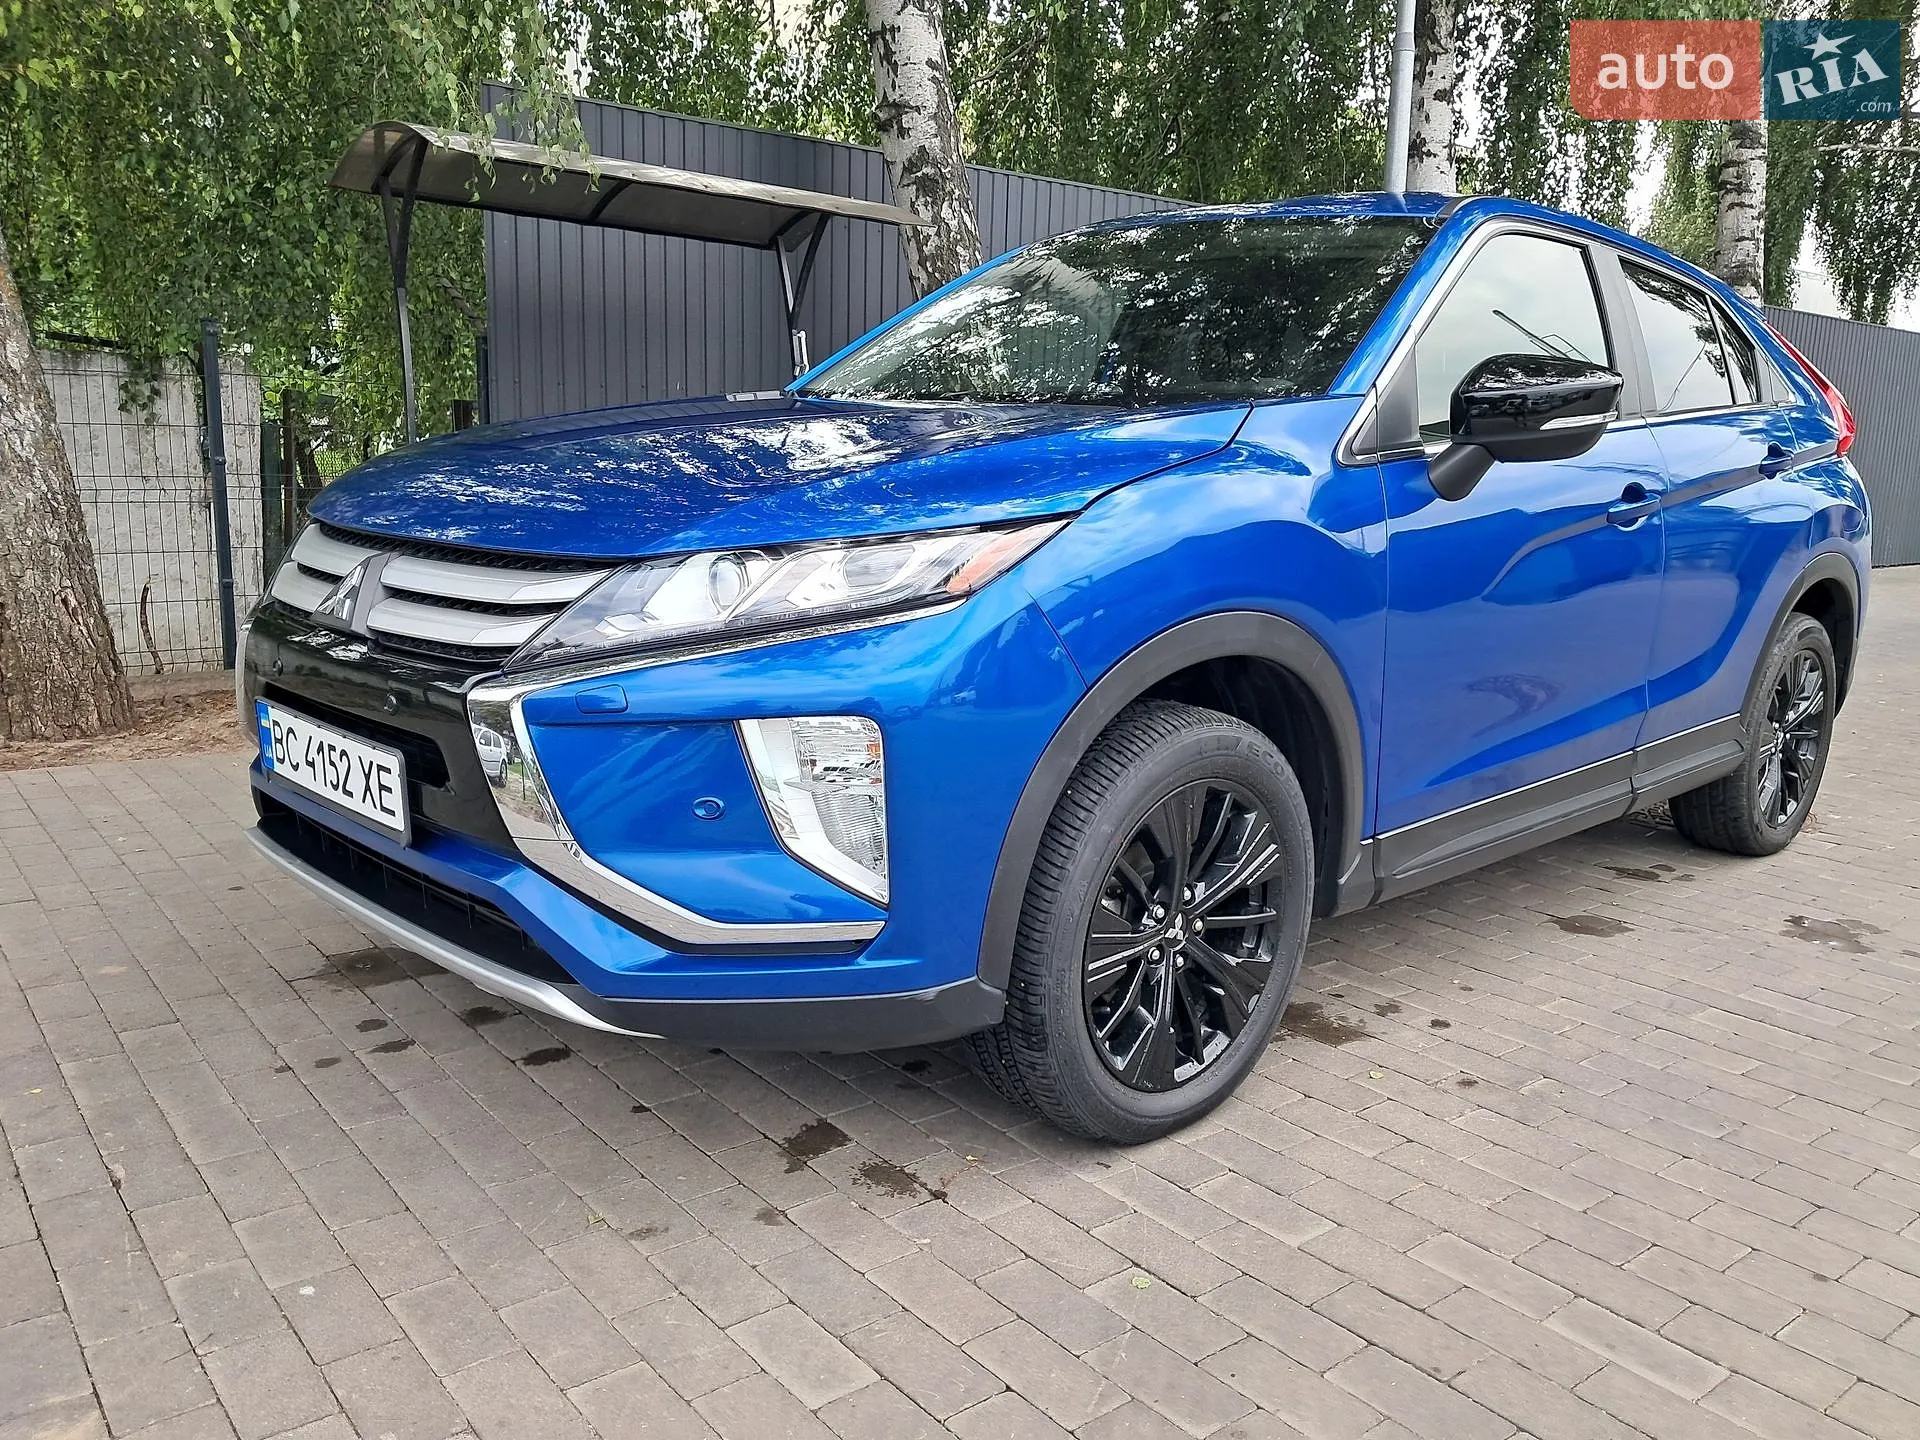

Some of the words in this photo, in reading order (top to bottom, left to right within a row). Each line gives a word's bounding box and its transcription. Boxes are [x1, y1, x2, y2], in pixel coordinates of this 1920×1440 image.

[272, 719, 300, 772] BC
[305, 735, 354, 799] 4152
[358, 755, 396, 817] XE
